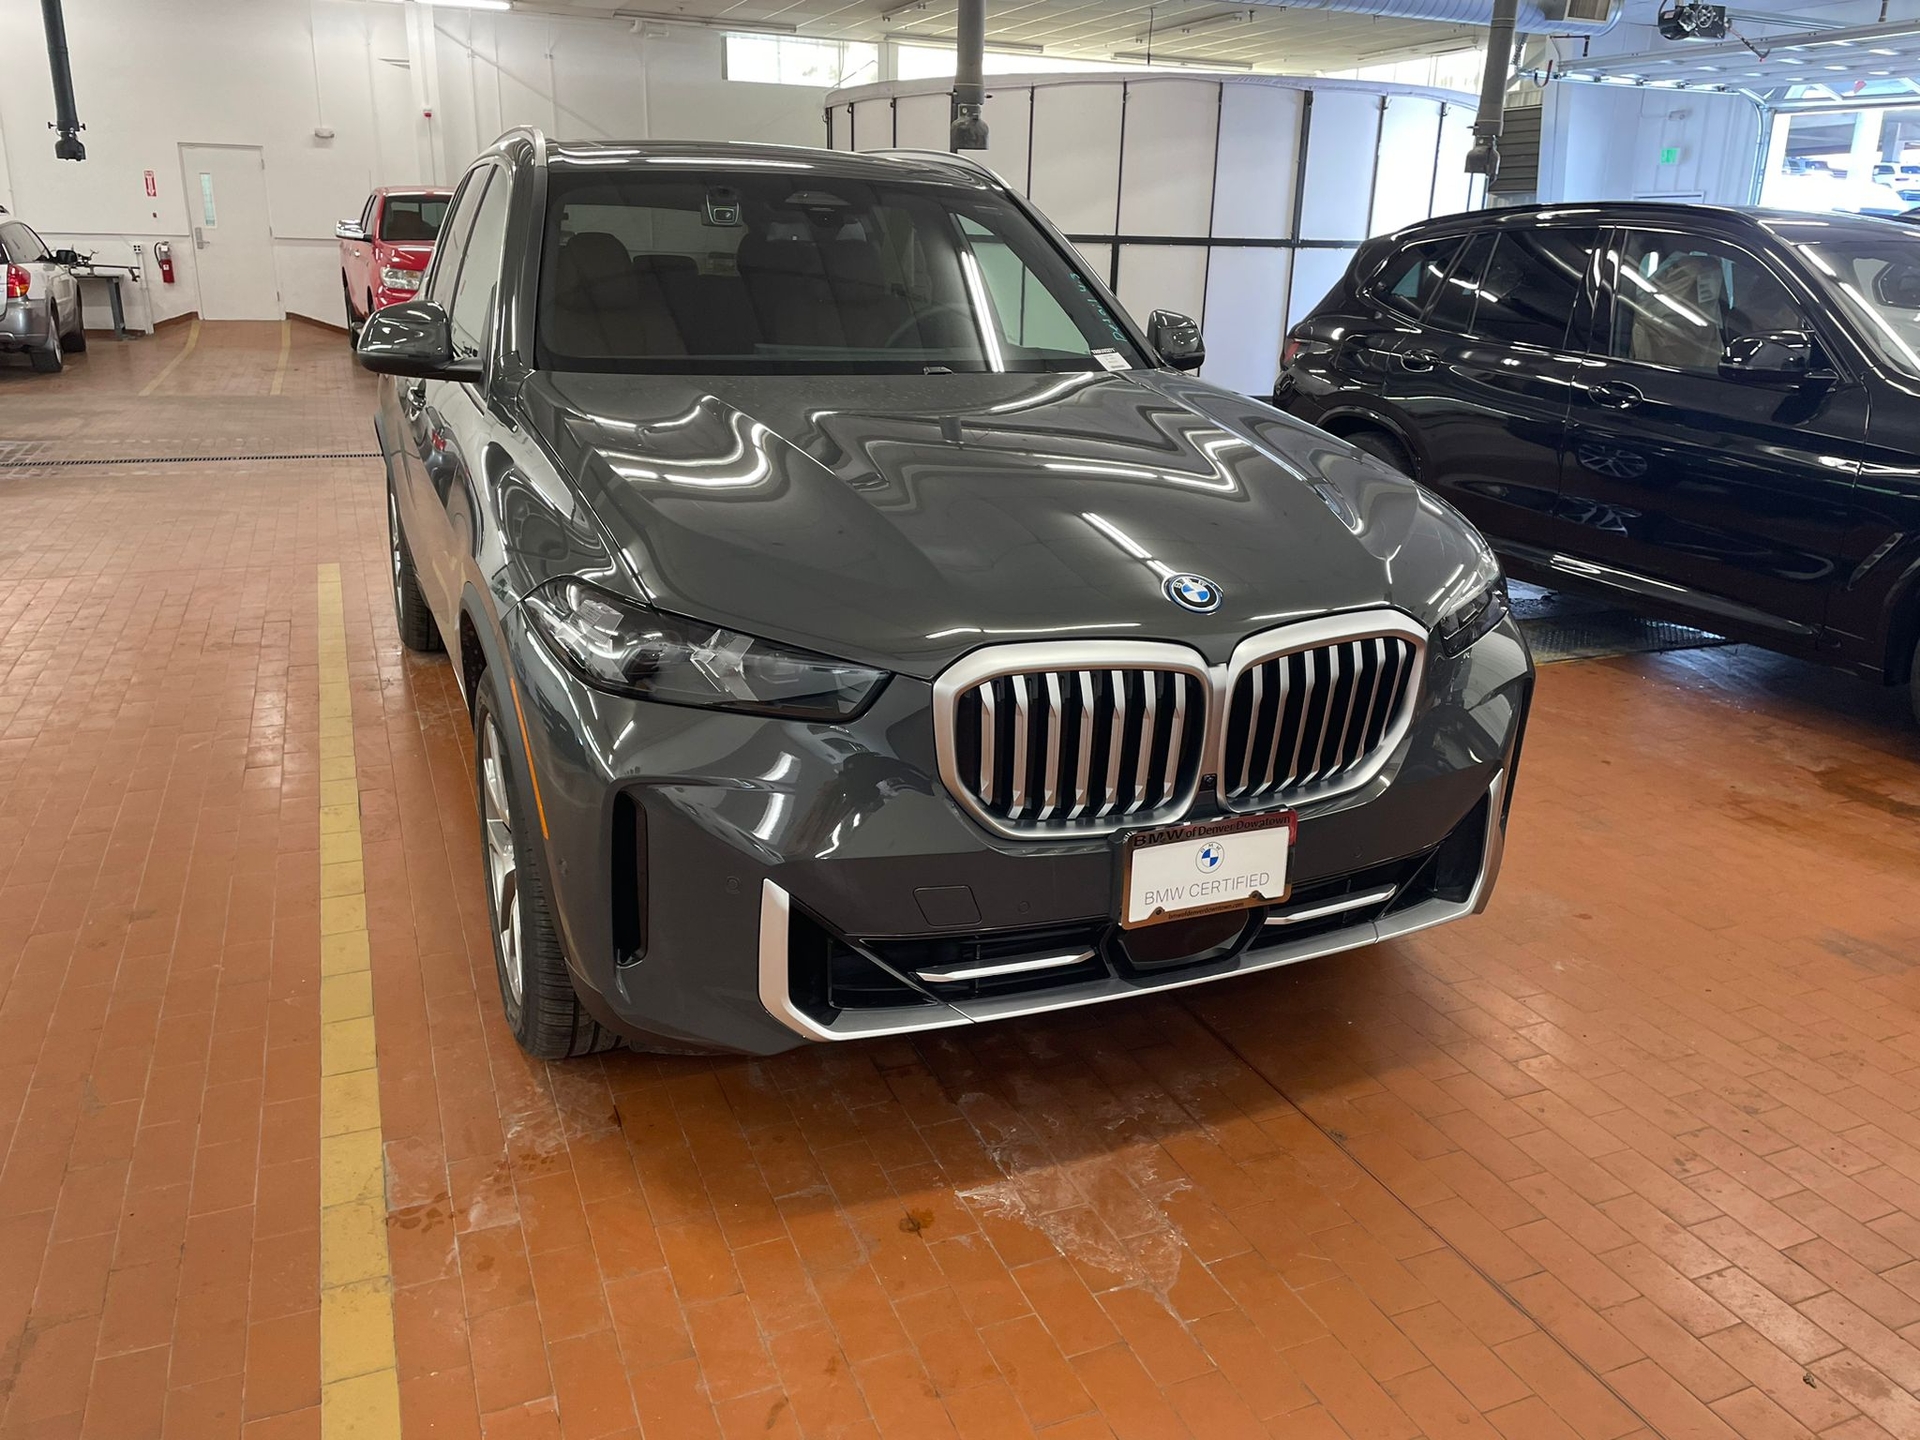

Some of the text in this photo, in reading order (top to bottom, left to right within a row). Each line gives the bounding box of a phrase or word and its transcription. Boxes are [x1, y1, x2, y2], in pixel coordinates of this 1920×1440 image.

[1133, 829, 1184, 847] BMW
[1185, 826, 1197, 838] of
[1198, 823, 1236, 836] Denver
[1144, 872, 1270, 906] BMW CERTIFIED
